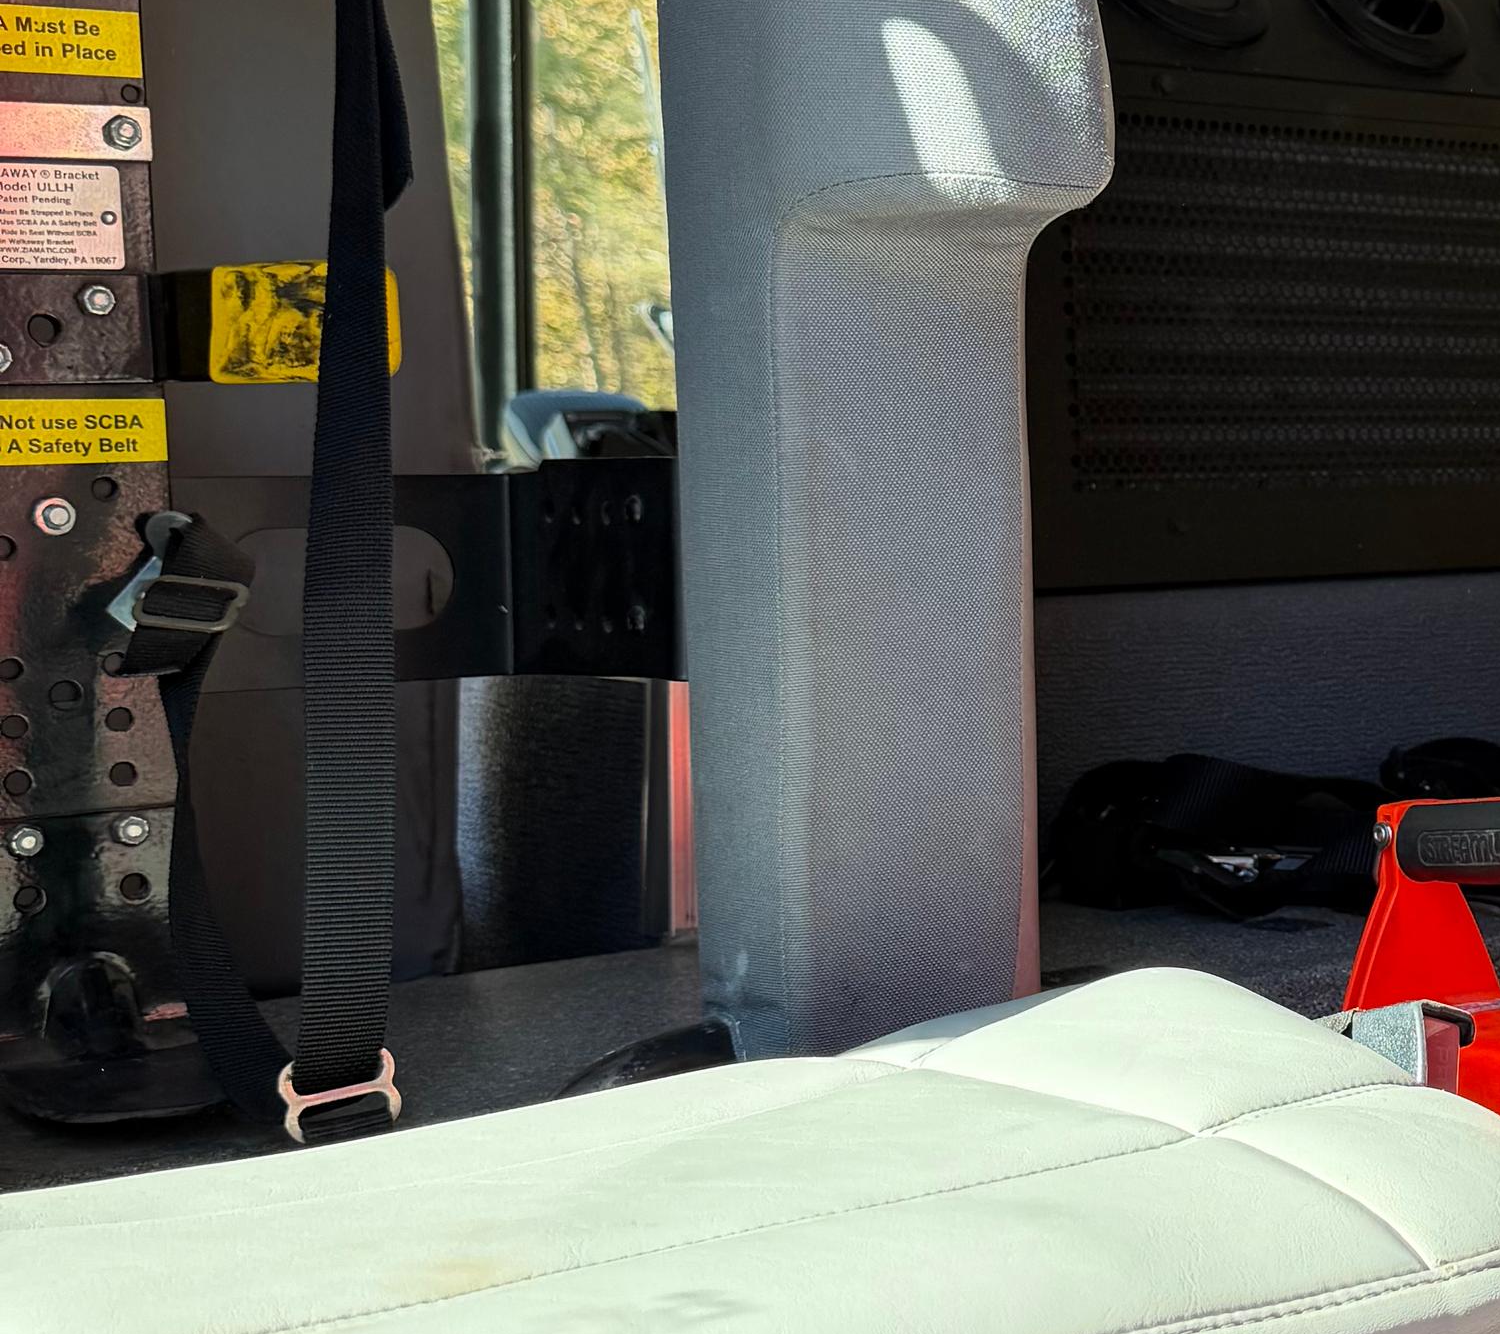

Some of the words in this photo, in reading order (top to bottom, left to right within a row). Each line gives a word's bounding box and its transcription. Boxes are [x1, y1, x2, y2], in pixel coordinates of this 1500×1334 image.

[15, 16, 66, 34] Must
[74, 20, 100, 36] Be
[0, 41, 26, 56] ed
[35, 42, 53, 57] in
[62, 43, 117, 61] Place
[54, 170, 100, 180] Bracket
[37, 183, 74, 192] ULLH
[32, 196, 71, 205] Pending
[0, 415, 35, 429] Not
[42, 418, 77, 429] use
[85, 415, 143, 429] SCBA
[8, 439, 22, 453] A
[29, 438, 92, 457] Safety
[100, 438, 138, 452] Belt
